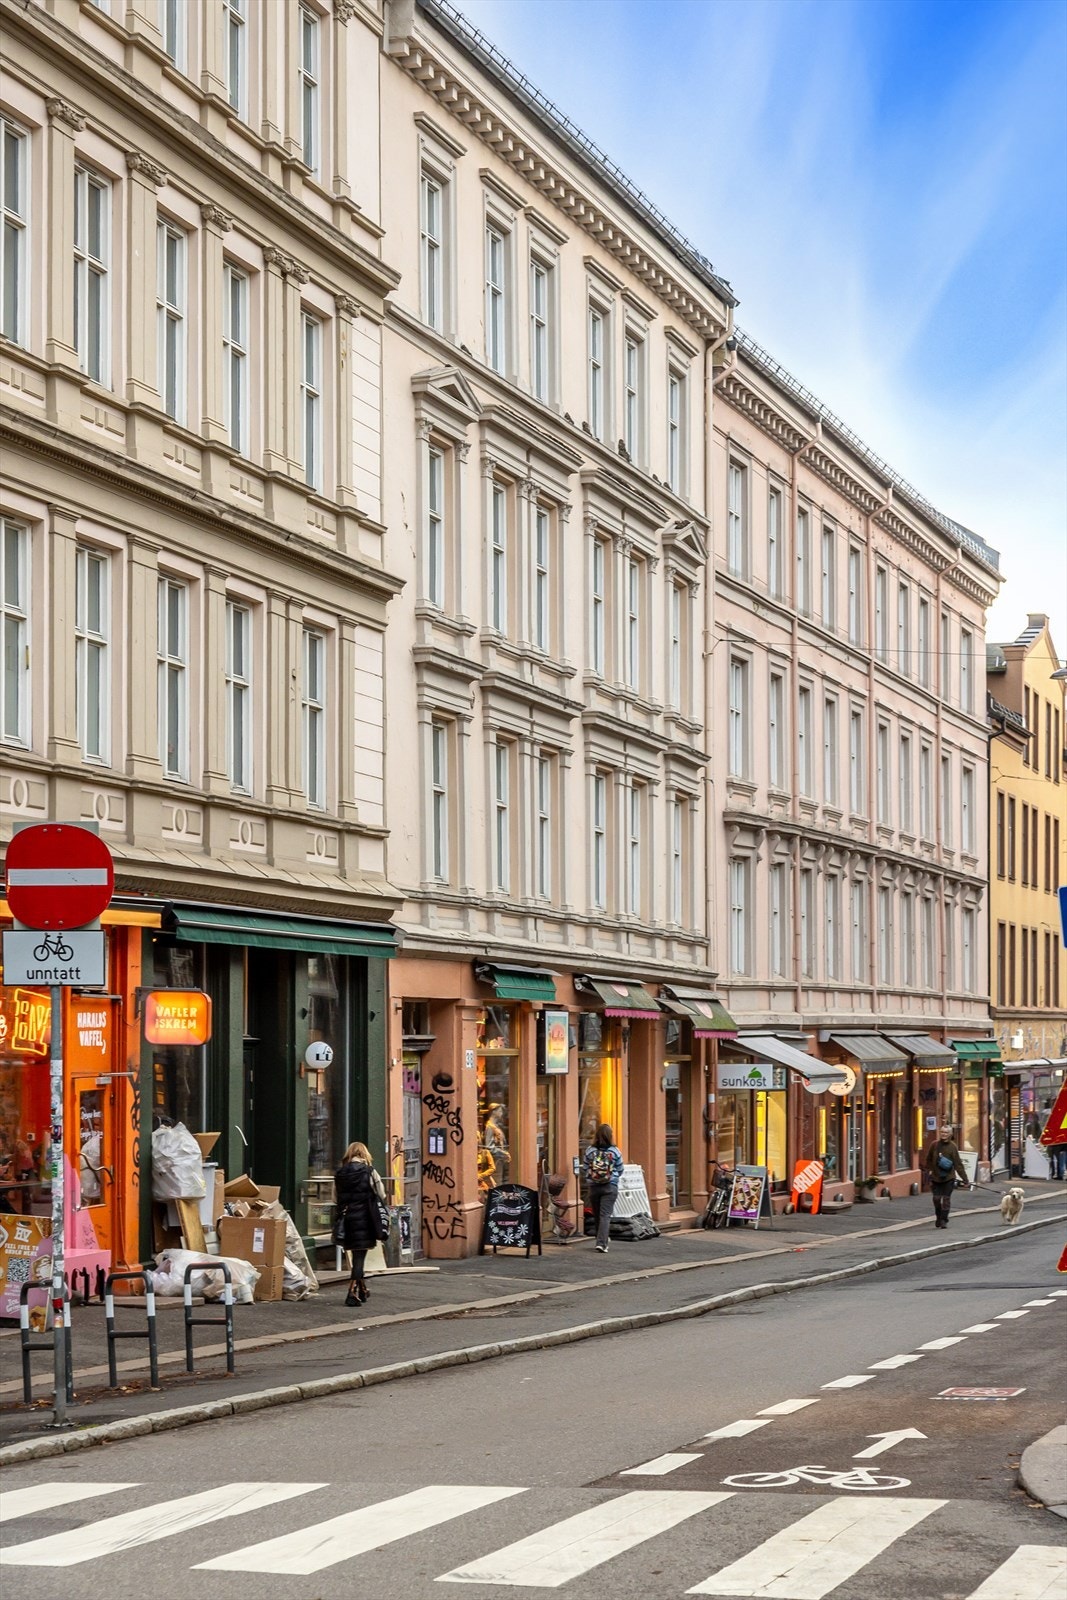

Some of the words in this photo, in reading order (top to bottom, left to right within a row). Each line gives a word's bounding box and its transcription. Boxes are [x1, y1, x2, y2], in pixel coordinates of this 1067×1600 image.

[26, 967, 81, 980] unntatt
[156, 1006, 198, 1018] VAFLER
[77, 1011, 107, 1028] HARALDS
[721, 1076, 767, 1087] sunkost
[423, 1215, 467, 1239] ICE
